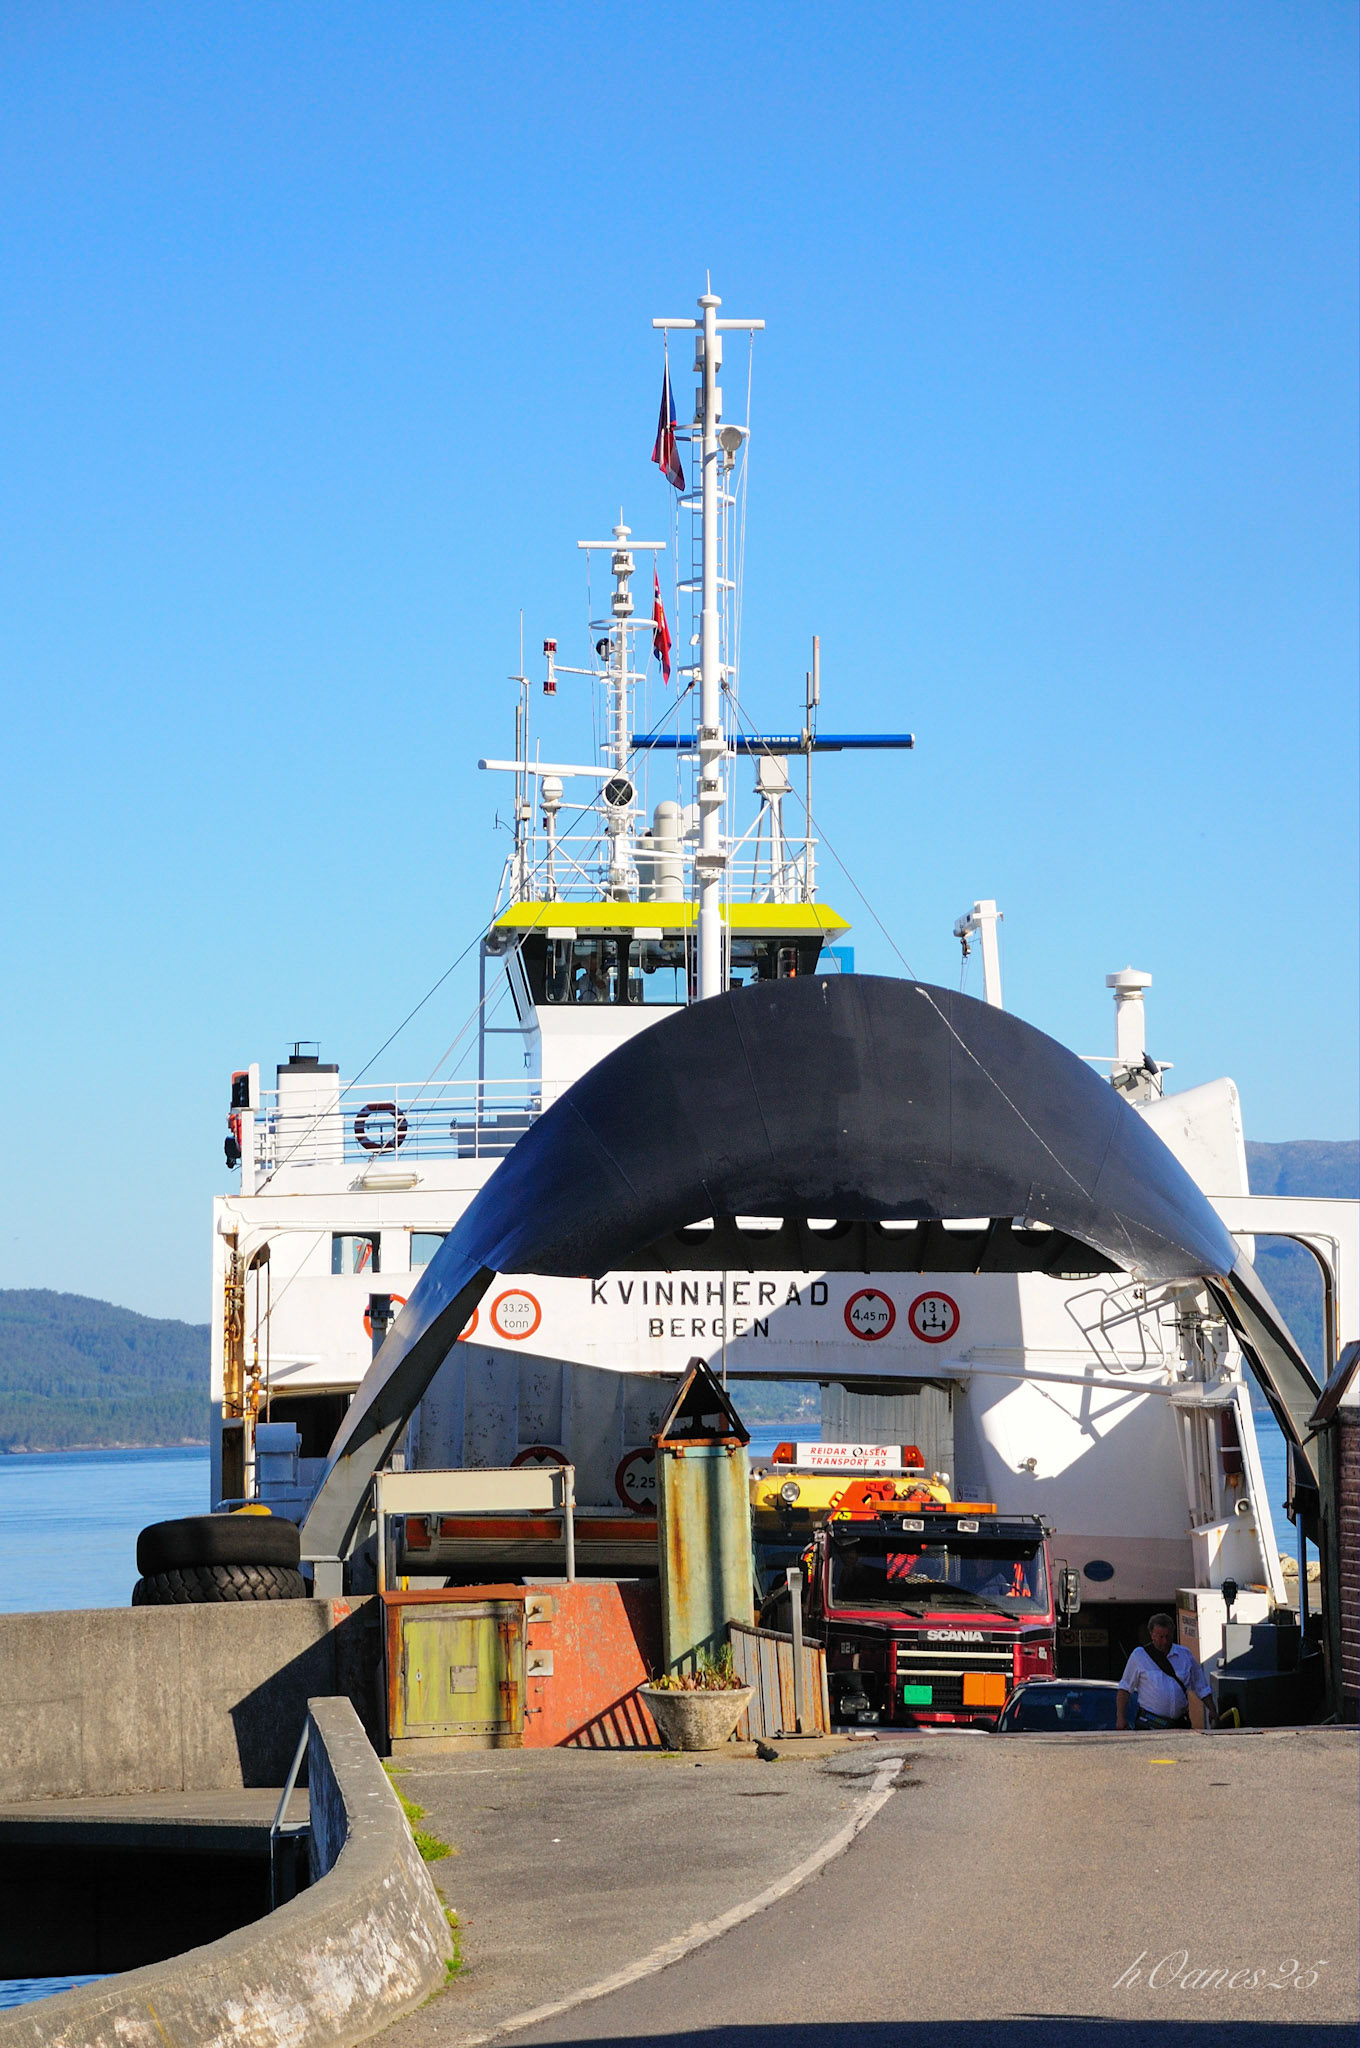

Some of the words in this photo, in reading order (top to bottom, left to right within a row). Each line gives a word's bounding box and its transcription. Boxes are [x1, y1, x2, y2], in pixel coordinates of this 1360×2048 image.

[591, 1280, 829, 1306] KVINNHERAD
[502, 1303, 530, 1313] 33.25
[922, 1301, 936, 1313] 13
[942, 1302, 947, 1313] t
[852, 1308, 876, 1321] 4.45
[878, 1312, 888, 1321] m
[504, 1319, 529, 1329] tonn
[649, 1317, 769, 1338] BERGEN
[810, 1447, 847, 1455] REIDAR
[811, 1457, 869, 1466] TRANSPORT
[626, 1472, 656, 1488] 2.25
[926, 1630, 984, 1642] SCANIA
